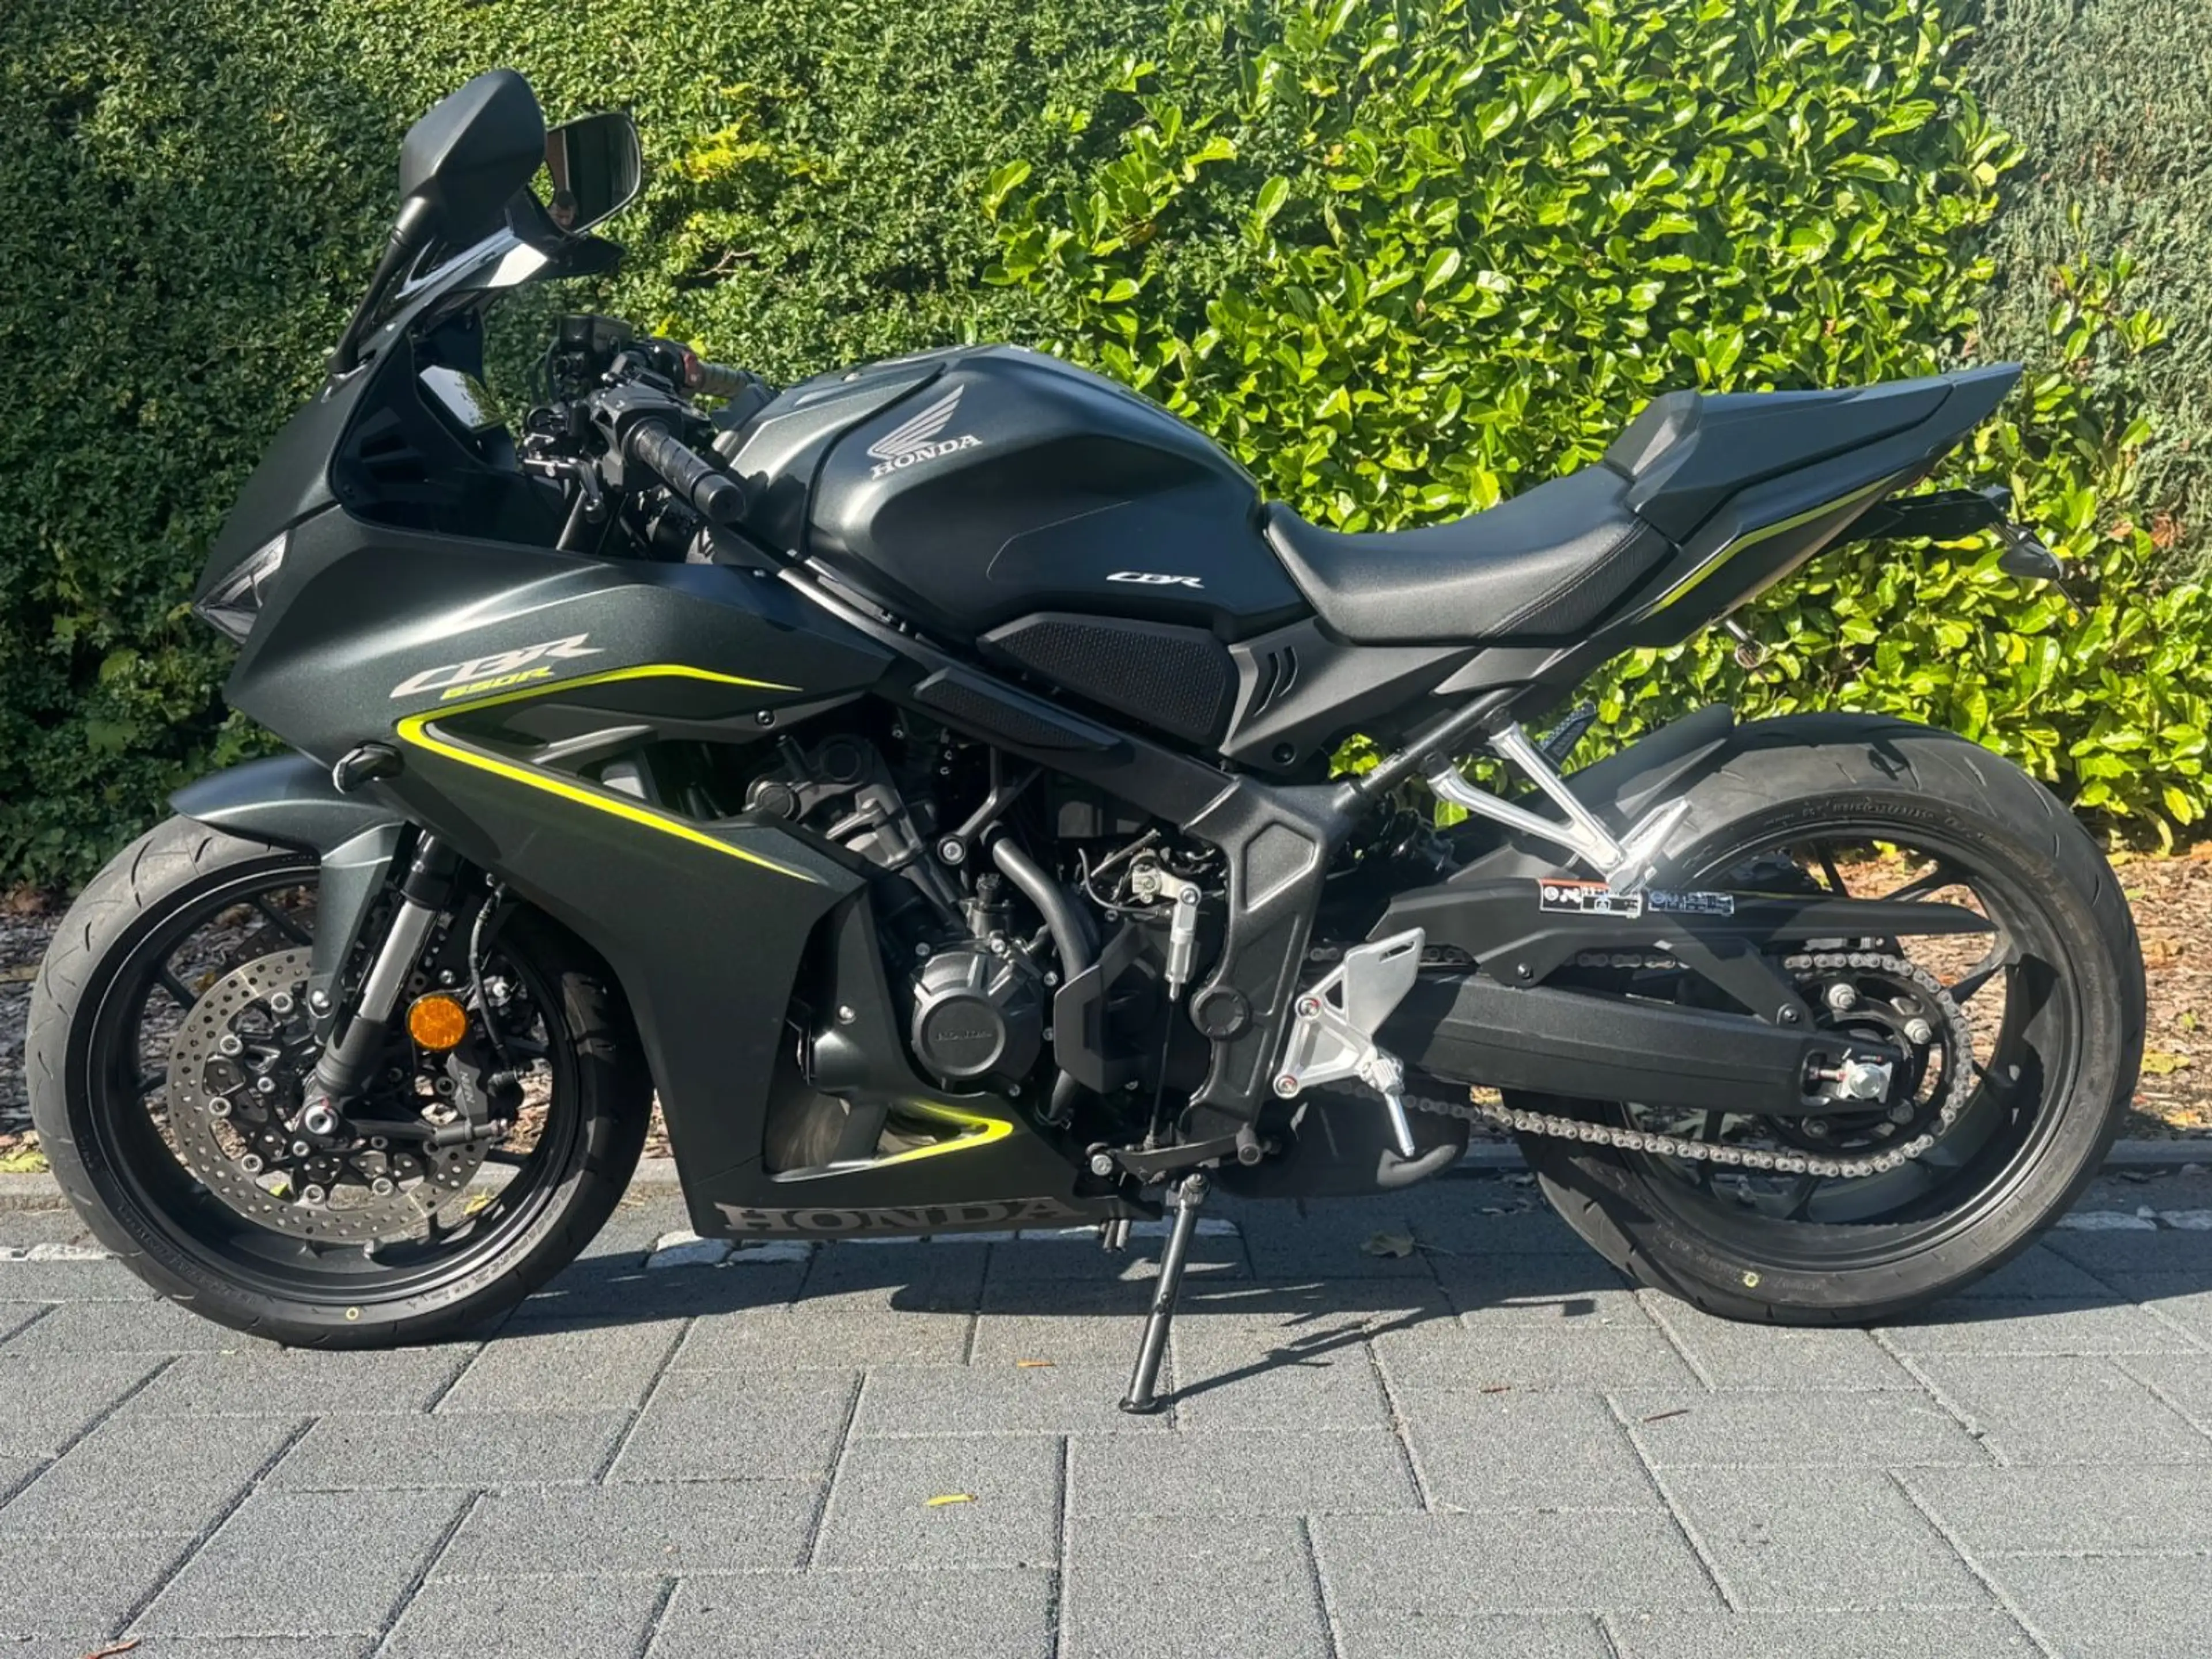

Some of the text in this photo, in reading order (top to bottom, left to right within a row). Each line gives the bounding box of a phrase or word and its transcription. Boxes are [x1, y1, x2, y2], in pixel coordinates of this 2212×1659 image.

[870, 434, 983, 480] HONDA
[1105, 571, 1205, 589] CBR
[389, 632, 605, 699] CBR
[440, 665, 556, 700] 650R
[713, 1196, 1088, 1232] HONDA
